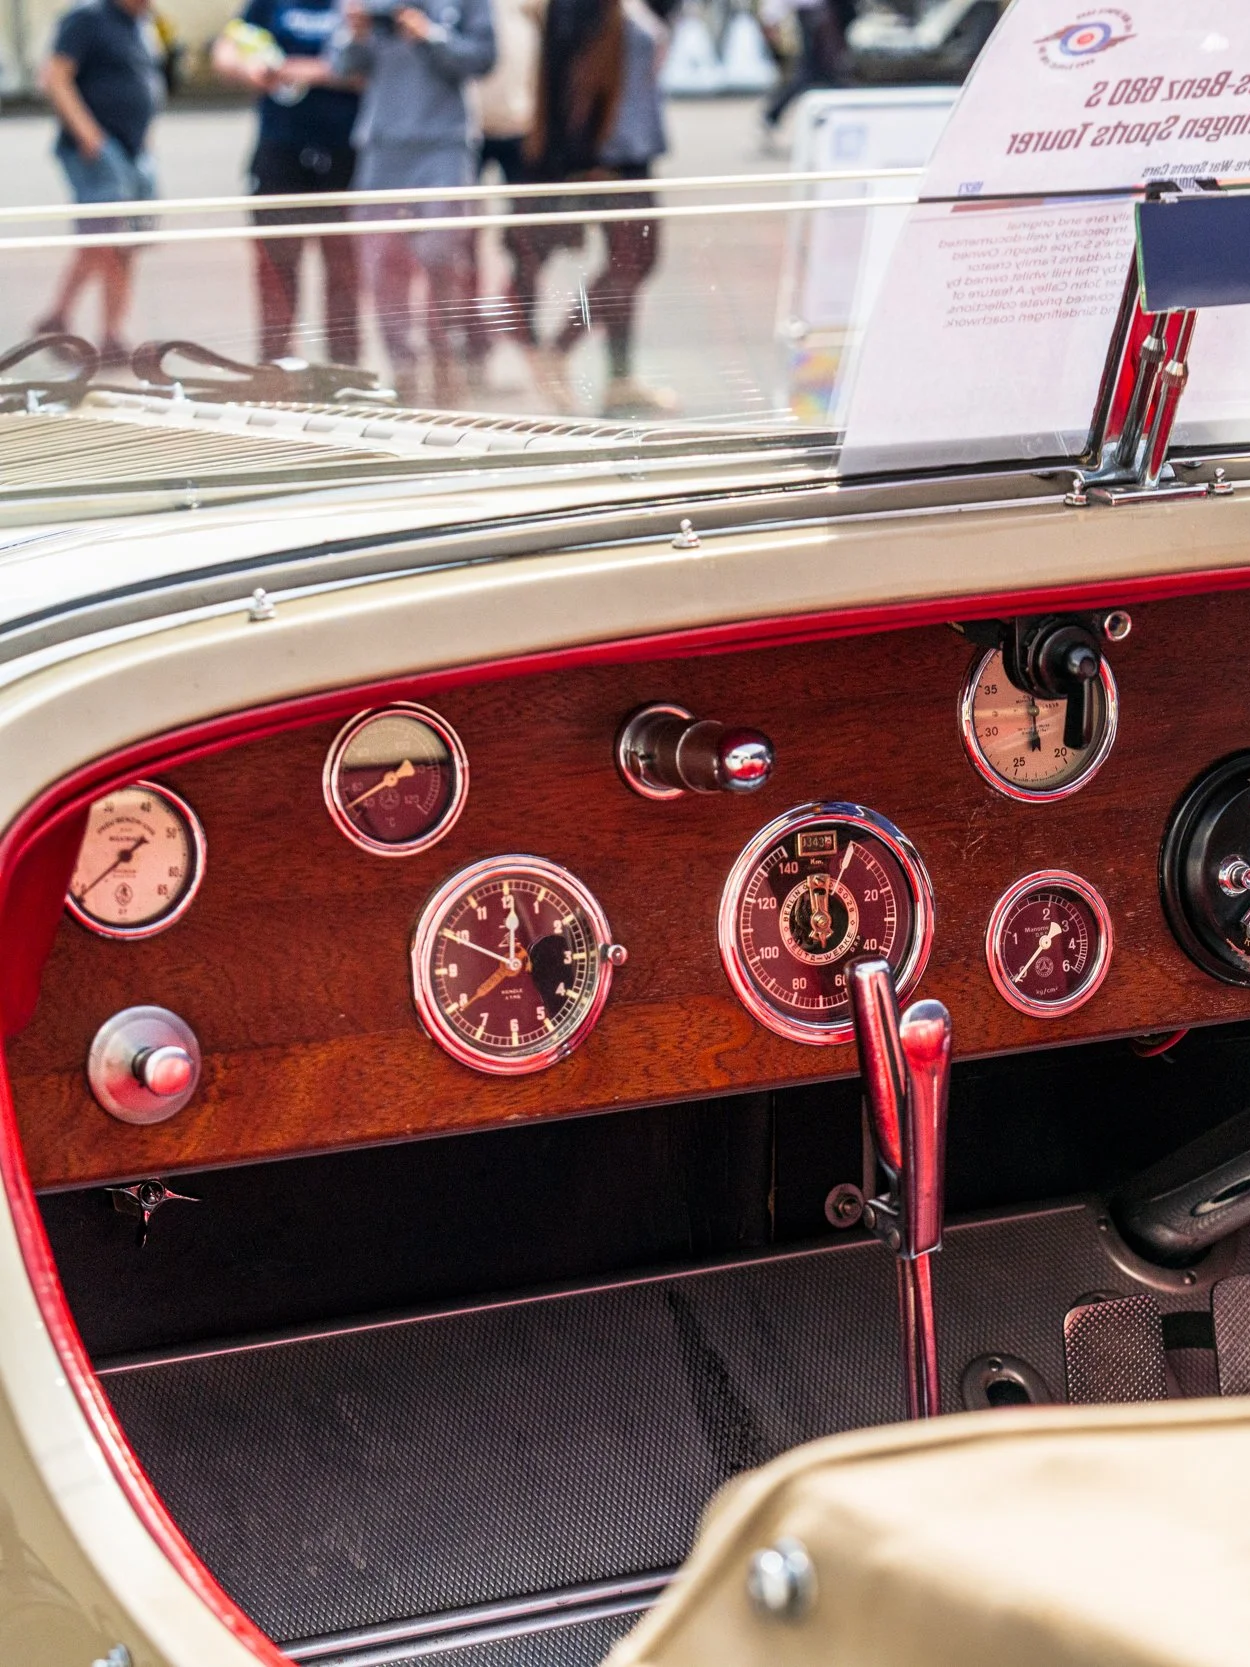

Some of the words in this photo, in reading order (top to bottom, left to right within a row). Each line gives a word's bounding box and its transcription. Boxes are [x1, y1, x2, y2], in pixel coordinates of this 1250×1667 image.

[984, 685, 998, 696] 35
[985, 727, 999, 738] 30
[1054, 747, 1068, 758] 20
[1013, 756, 1027, 768] 25
[779, 862, 798, 874] 140
[864, 889, 879, 903] 20
[533, 902, 540, 914] 1
[757, 896, 777, 910] 120
[783, 889, 801, 922] BERLIN
[477, 907, 488, 920] 11
[1042, 908, 1050, 920] 2
[553, 919, 563, 934] 2
[1061, 920, 1070, 932] 3
[863, 938, 877, 951] 40
[1012, 933, 1019, 945] 1
[1068, 938, 1077, 950] 4
[759, 946, 780, 960] 100
[787, 931, 854, 962] DEUTA-WERKE
[563, 950, 572, 964] 3
[448, 964, 458, 977] 9
[1062, 960, 1071, 972] 6
[555, 982, 566, 996] 4
[792, 976, 806, 990] 80
[536, 1006, 546, 1020] 5
[480, 1013, 489, 1027] 7
[510, 1018, 519, 1031] 6
